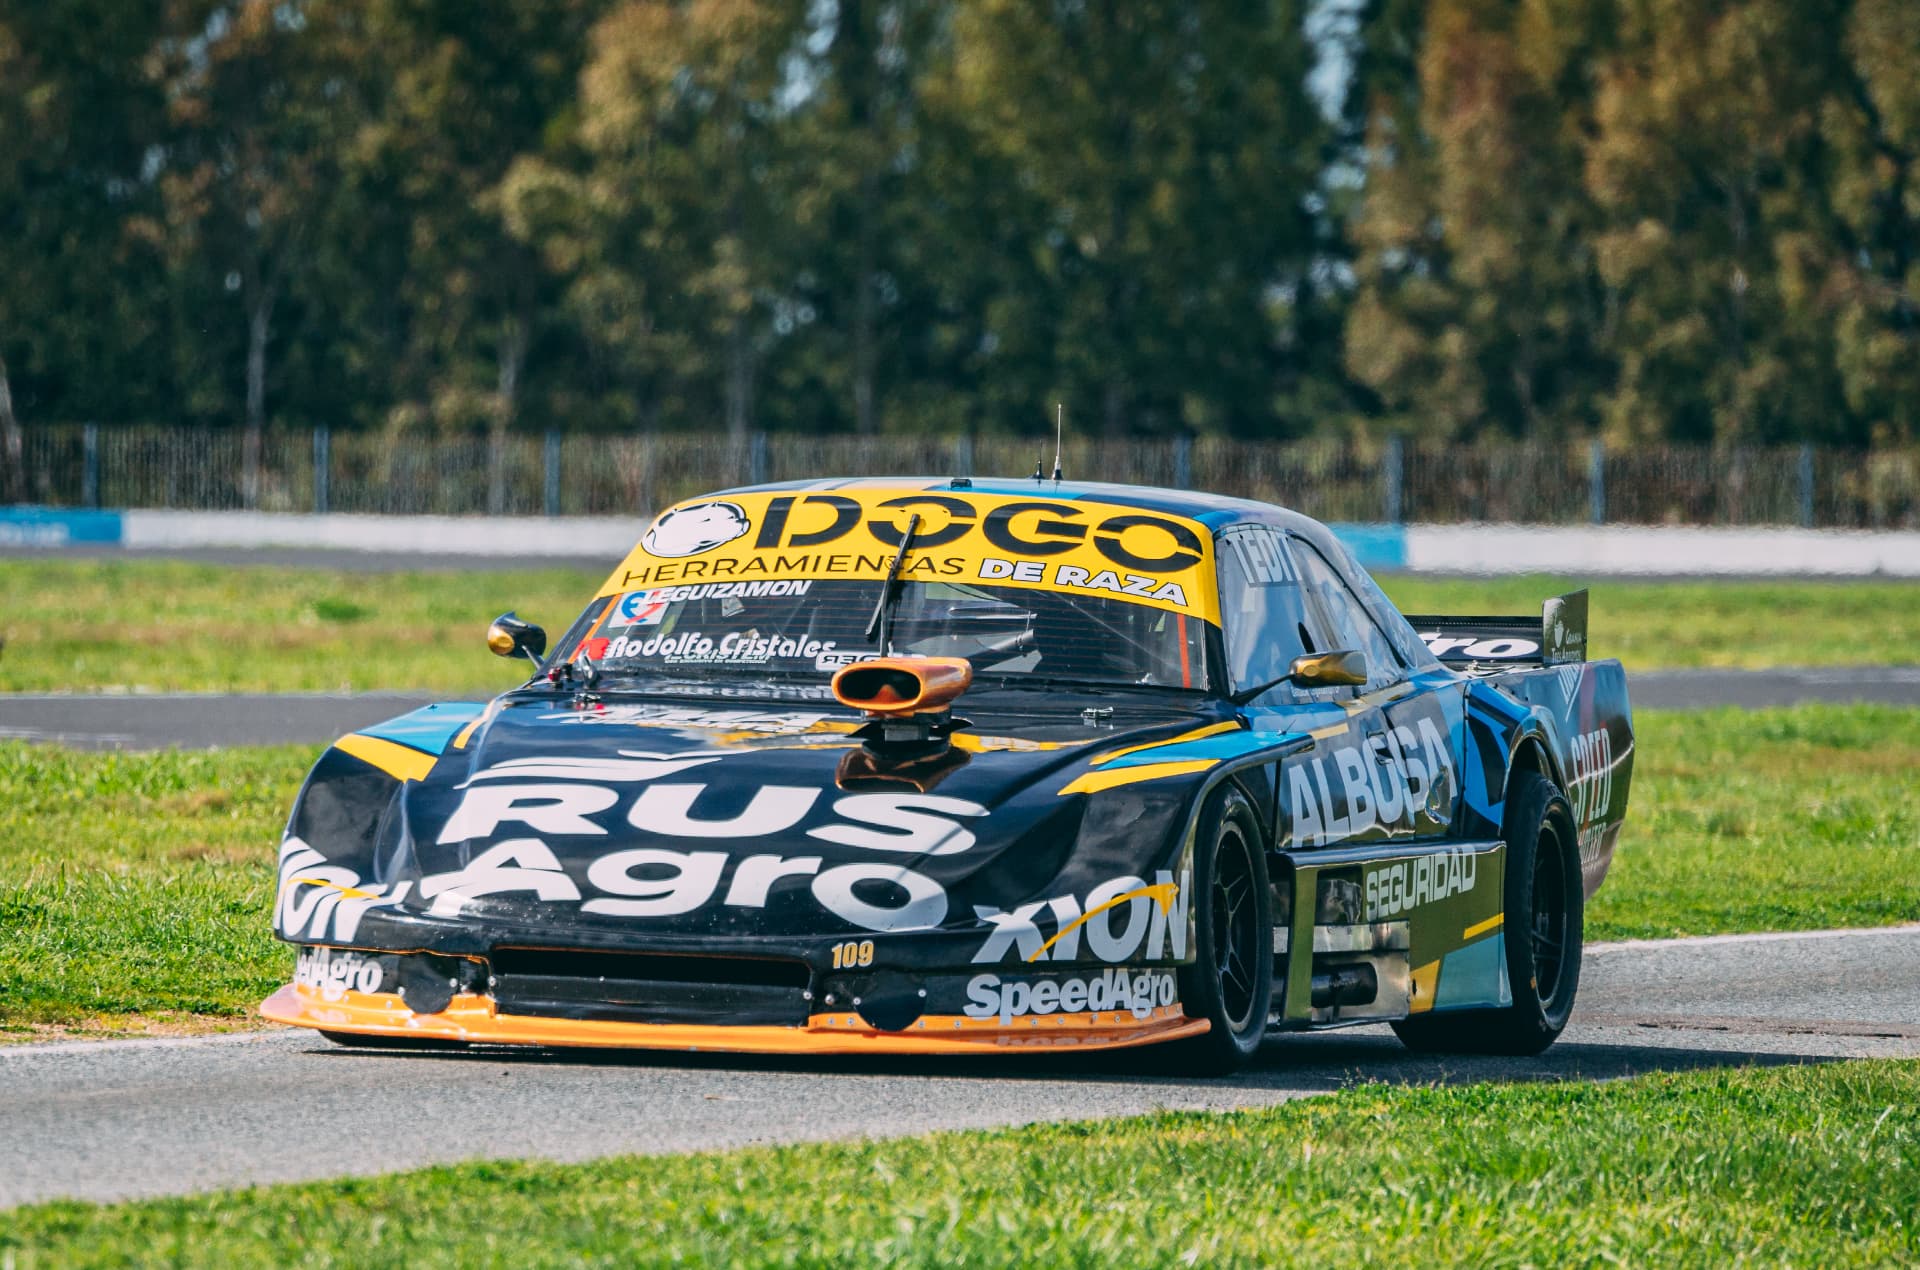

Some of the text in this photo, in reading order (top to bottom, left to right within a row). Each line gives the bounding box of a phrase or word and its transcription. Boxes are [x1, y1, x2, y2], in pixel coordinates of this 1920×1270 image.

[754, 495, 1204, 573] DOGO
[978, 558, 1047, 583] DE
[1055, 565, 1188, 607] RAZA
[607, 632, 838, 659] Rodolfo Cristales
[1570, 727, 1612, 824] SPEED
[436, 784, 990, 855] RUS
[420, 838, 948, 933] Agro
[970, 870, 1190, 963] XION
[1366, 844, 1477, 923] SEGURIDAD
[831, 940, 874, 969] 109
[962, 968, 1177, 1026] SpeedAgro
